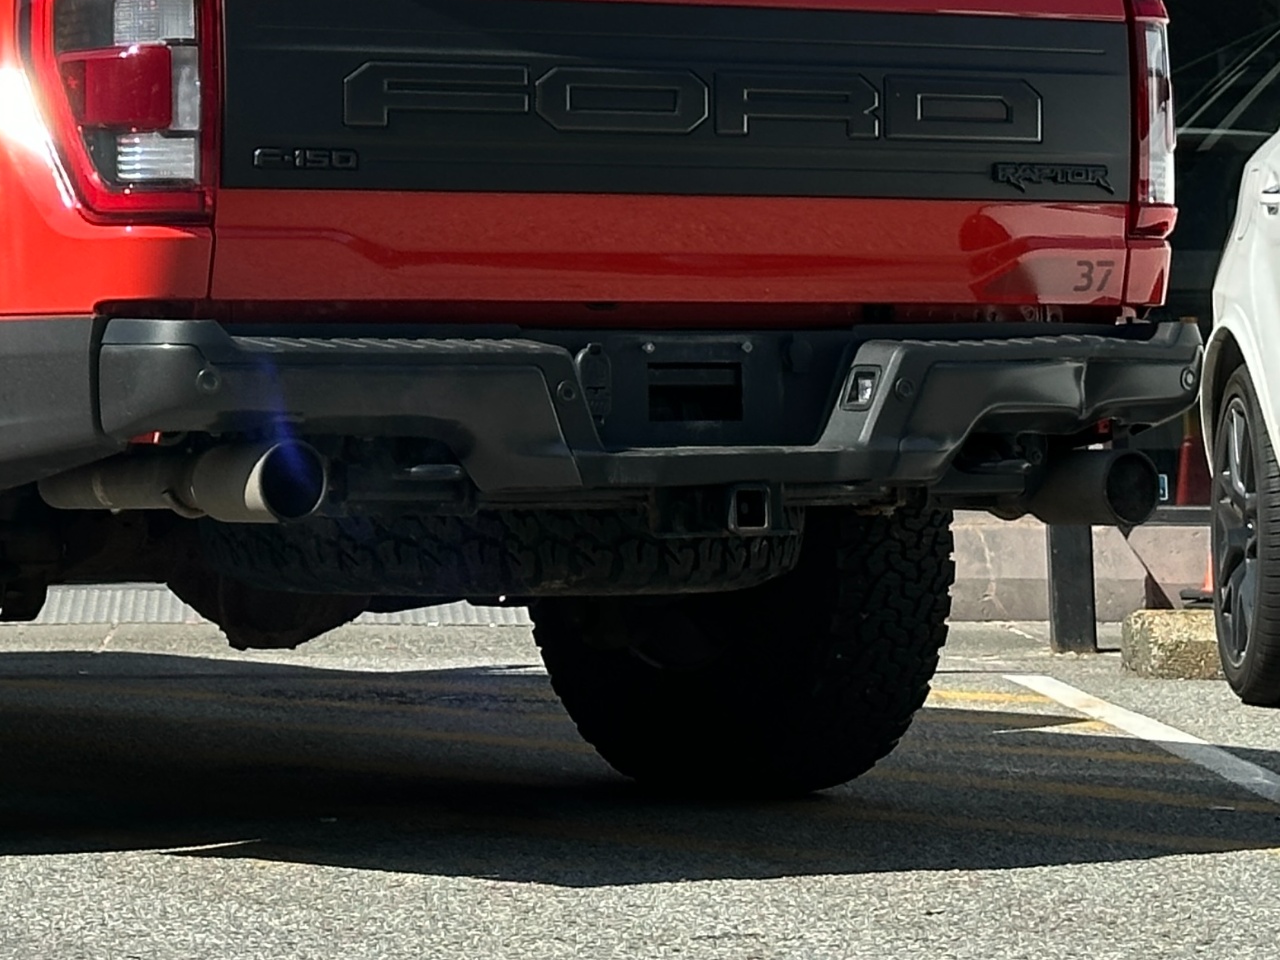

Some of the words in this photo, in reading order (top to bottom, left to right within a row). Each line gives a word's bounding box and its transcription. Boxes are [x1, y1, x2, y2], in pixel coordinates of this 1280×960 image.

[343, 61, 1043, 142] FORD
[253, 147, 358, 169] F-150
[993, 163, 1115, 195] RAPTOR
[1072, 259, 1115, 292] 37
